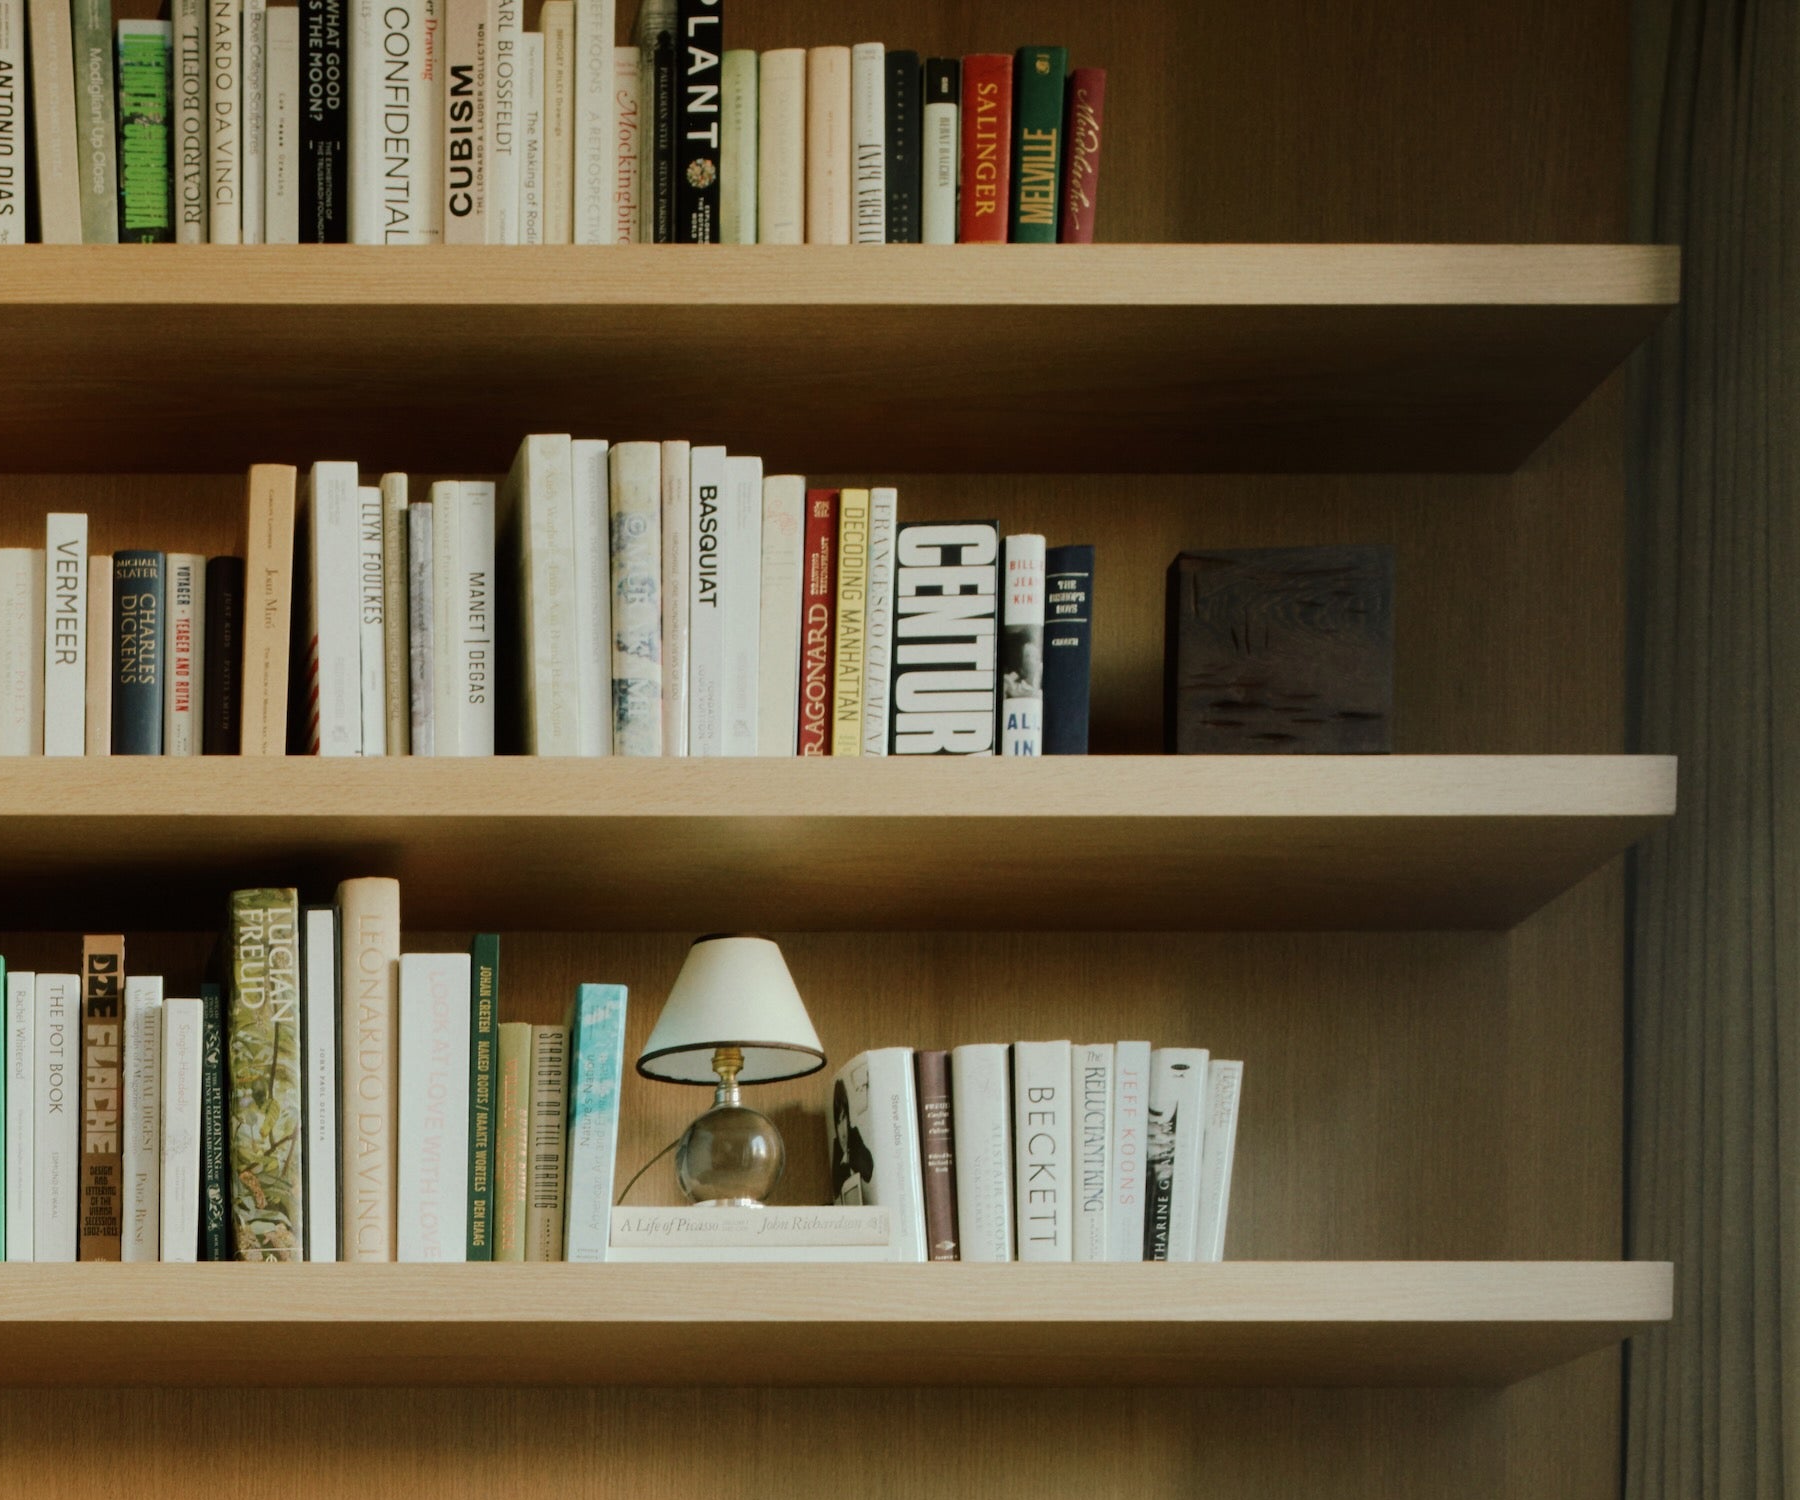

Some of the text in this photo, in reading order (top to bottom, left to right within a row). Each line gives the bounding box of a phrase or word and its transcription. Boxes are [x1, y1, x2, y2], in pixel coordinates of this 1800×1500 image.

[88, 47, 106, 194] Modigliani Up Close
[183, 27, 201, 225] RICARDO BOFILL
[384, 7, 409, 245] CONFIDENTIAL
[449, 65, 474, 218] CUBISM
[496, 40, 514, 156] BLOSSFELDT
[975, 83, 998, 217] SALINGER
[1071, 89, 1099, 230] Mendelssohn
[1020, 128, 1057, 224] MELVILLE
[55, 540, 79, 665] VERMEER
[361, 503, 383, 625] LLYN FOULKES
[698, 485, 718, 608] BASQUIAT
[120, 594, 137, 684] DICKENS
[139, 593, 157, 685] CHARLES
[175, 566, 191, 712] VOYAGER YEAGER AND RUTAN
[469, 572, 486, 704] MANET DEGAS
[838, 507, 865, 722] DECODING MANHATTAN
[238, 909, 265, 1009] FREUD
[268, 907, 294, 1022] LUCIAN
[49, 984, 64, 1115] THE POT BOOK
[534, 1032, 562, 1210] STRAIGHT ON TILL MORNING
[891, 1094, 903, 1146] Steve Jobs
[1027, 1086, 1057, 1247] BECKETT
[1119, 1067, 1137, 1206] JEFF KOONS
